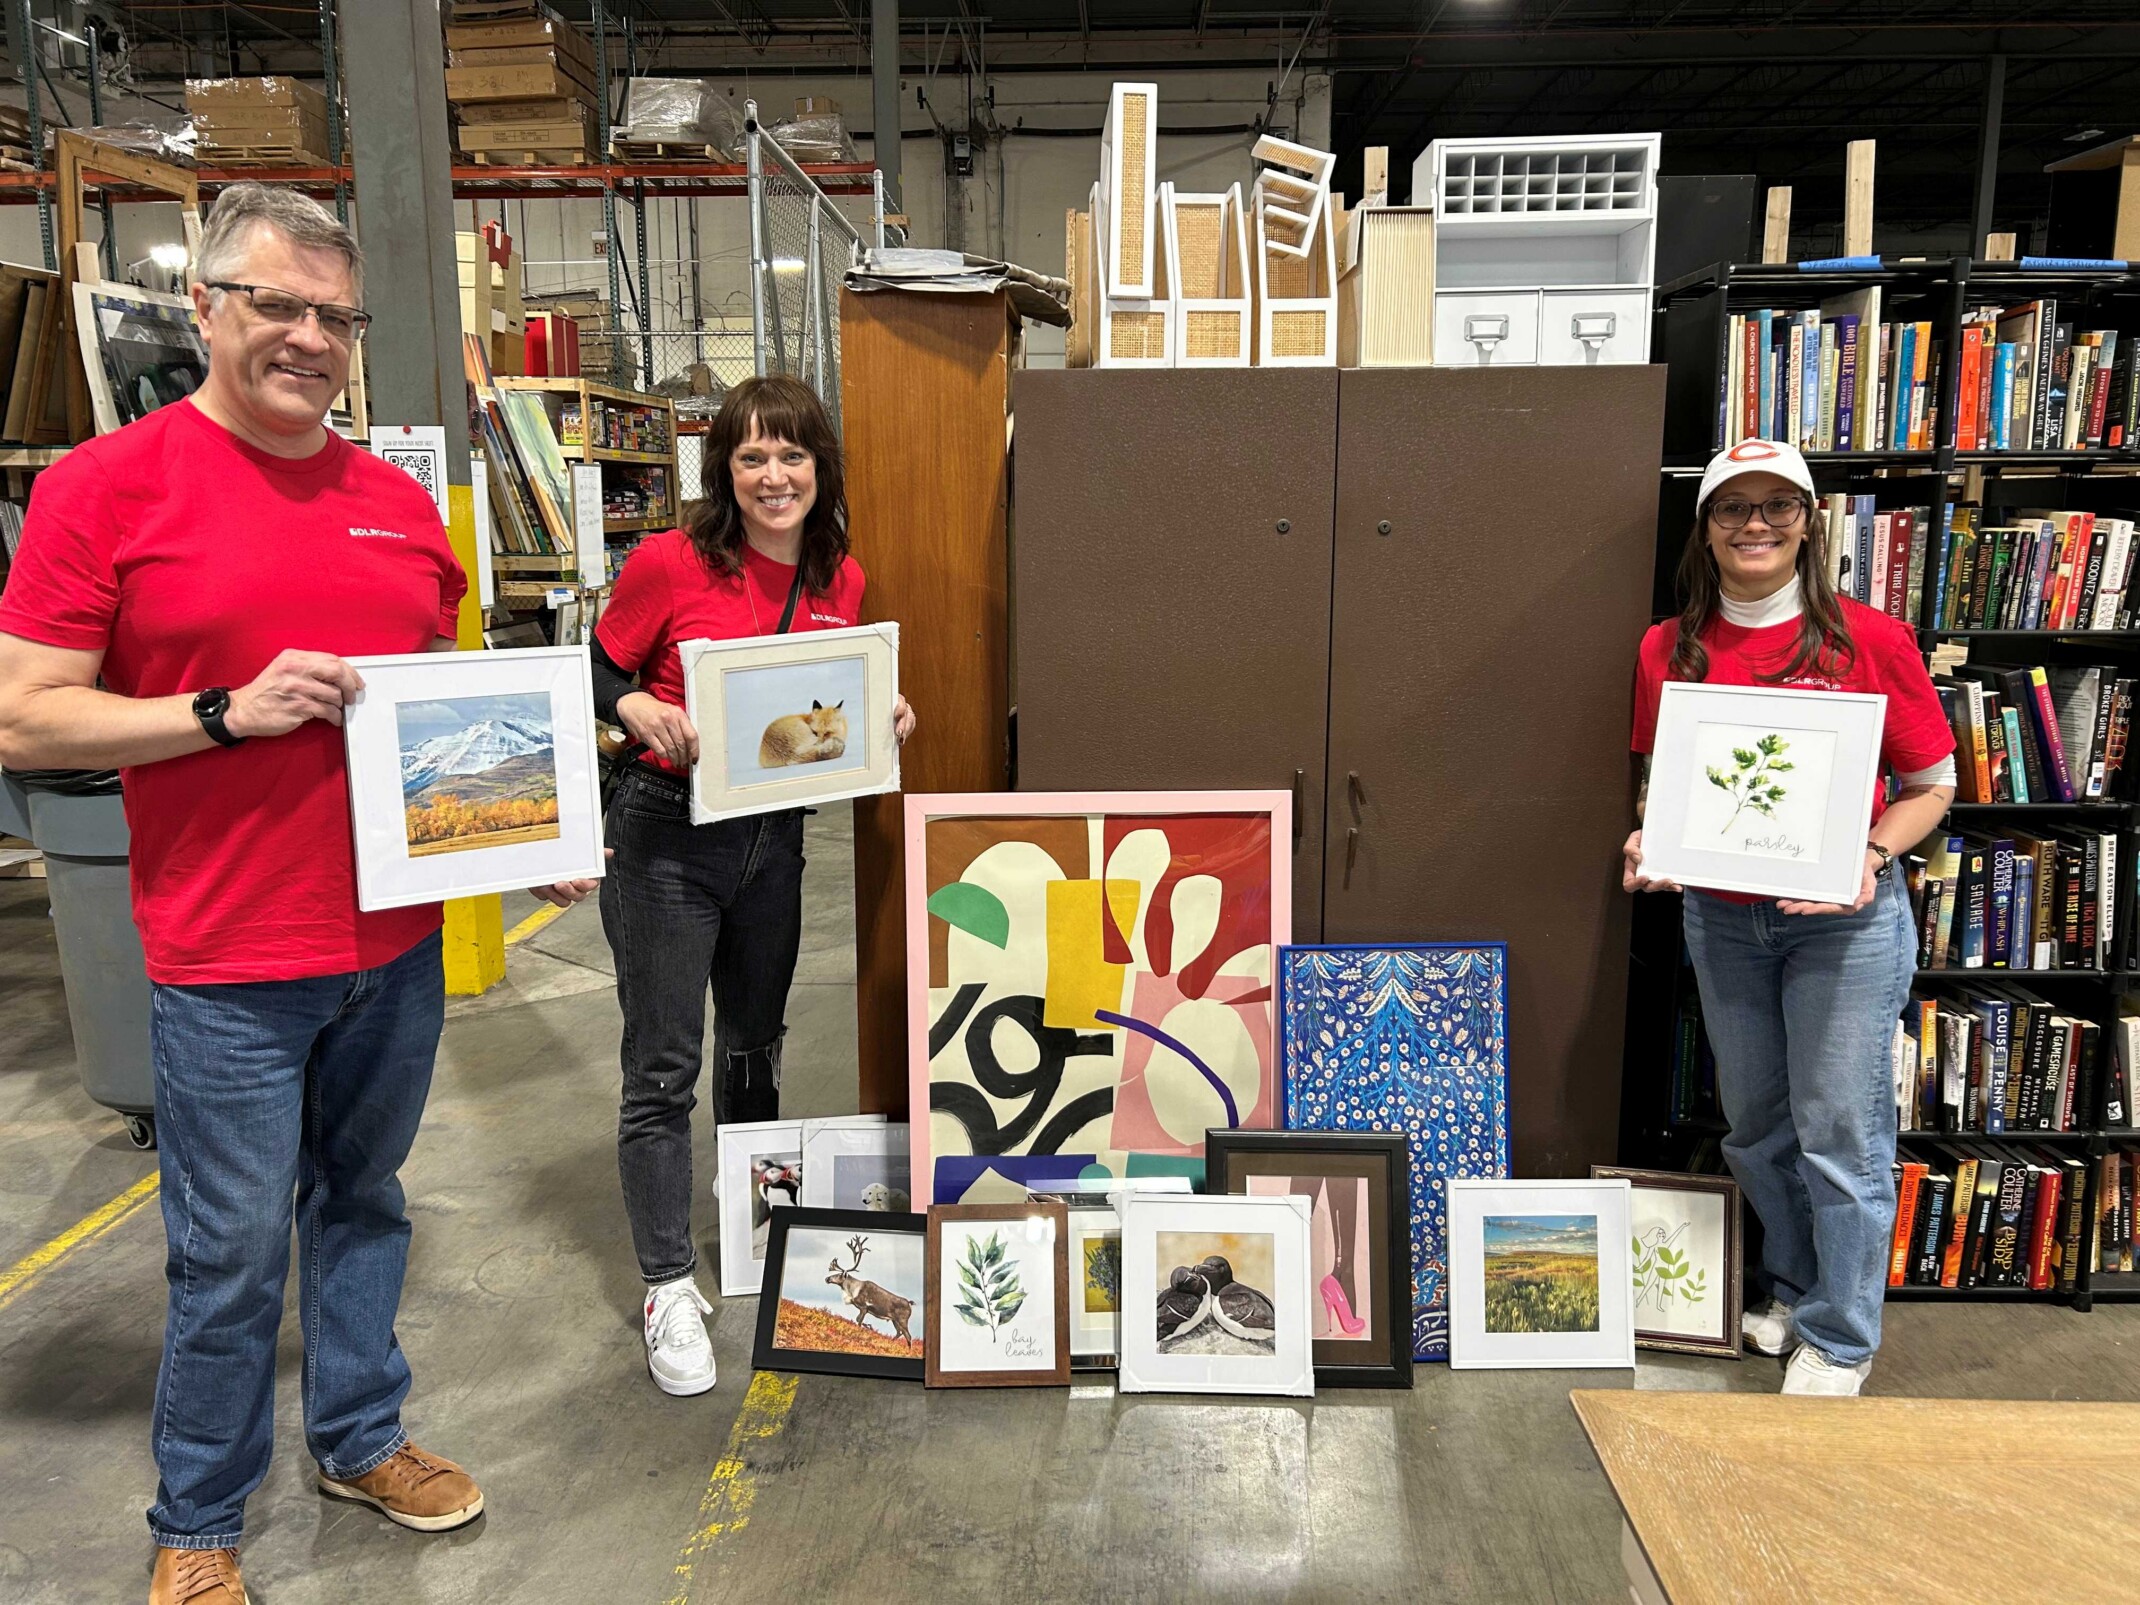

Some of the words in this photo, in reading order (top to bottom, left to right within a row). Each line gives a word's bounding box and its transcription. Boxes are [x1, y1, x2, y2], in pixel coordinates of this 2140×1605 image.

[595, 242, 607, 254] EXI
[1845, 324, 1855, 343] 1001
[2043, 307, 2052, 338] MARTHA
[1749, 355, 1755, 365] ON
[1842, 344, 1856, 375] BIBLE
[2041, 340, 2049, 369] GRIMES
[2038, 373, 2047, 411] FADEAWAY
[2098, 371, 2106, 394] BEFORE
[1790, 380, 1799, 414] TRAVELED
[1807, 395, 1815, 421] JENNINGS
[2075, 388, 2084, 412] HIGGINS
[2097, 400, 2103, 408] GO
[2036, 414, 2044, 431] GIRL
[2050, 419, 2058, 437] LISA
[2067, 525, 2077, 561] PERFUME
[2078, 546, 2086, 564] HOPE
[2114, 536, 2125, 561] JEFFERY
[1979, 545, 1987, 569] LAYMON
[1892, 562, 1904, 589] BIBLE
[1978, 572, 1988, 585] COME
[2074, 566, 2082, 587] NEVER
[2084, 560, 2101, 595] KOONTZ
[2109, 562, 2120, 587] DEAVER
[1976, 586, 1986, 596] OUT
[2071, 589, 2079, 604] DIES
[1890, 592, 1902, 618] HOLY
[1973, 597, 1985, 619] TONIGHT
[1988, 600, 1998, 629] GERRITSEN
[2097, 598, 2107, 625] MOON
[2105, 603, 2114, 627] COLD
[1972, 687, 1982, 724] CHOPPING
[2100, 684, 2112, 715] BROKEN
[2043, 698, 2053, 721] STRANGER
[2049, 722, 2059, 743] UPSTAIRS
[2097, 717, 2107, 739] GIRLS
[2060, 767, 2068, 783] MATLIN
[1745, 834, 1804, 857] parsley
[2086, 839, 2097, 858] JAMES
[1993, 851, 2005, 892] COULTER
[2005, 850, 2013, 892] CATHERINE
[2043, 846, 2053, 875] RUTH
[2068, 879, 2080, 893] THE
[2085, 860, 2096, 892] PATTERSON
[1943, 886, 1956, 914] FURY
[1969, 884, 1984, 929] SALVAGE
[2041, 878, 2051, 908] WARE
[2067, 895, 2078, 912] RISE
[2066, 914, 2078, 924] OF
[2084, 901, 2095, 922] TICK
[1996, 907, 2007, 951] WHIPLASH
[2040, 921, 2048, 930] IT
[2065, 925, 2077, 943] NINE
[2082, 925, 2094, 948] TOCK
[1997, 1008, 2007, 1053] LOUISE
[2015, 1007, 2026, 1037] CRICHTON
[2032, 1014, 2046, 1068] DISCLOSURE
[2010, 1040, 2024, 1073] PATTERSON
[2045, 1036, 2063, 1091] GAMESHOUSE
[1993, 1071, 2003, 1112] PENNY
[2005, 1082, 2019, 1119] ERUPTION
[2019, 1075, 2031, 1119] CRICHTON
[2030, 1078, 2041, 1117] MICHAEL
[2065, 1091, 2073, 1118] SHADOWS
[1968, 1097, 1978, 1121] JOHANSEN
[1964, 1165, 1974, 1182] JAMES
[2073, 1170, 2084, 1199] CRICHTON
[1904, 1181, 1914, 1201] DAVID
[1959, 1184, 1972, 1214] PATTERSON
[1999, 1168, 2016, 1211] COULTER
[2013, 1169, 2027, 1211] CATHERINE
[1932, 1194, 1943, 1215] JAMES
[1899, 1204, 1910, 1236] BALDACCI
[1953, 1214, 1968, 1245] BURN
[2069, 1202, 2082, 1235] PATTERSON
[1925, 1217, 1940, 1254] PATTERSON
[1893, 1248, 1906, 1273] FALLEN
[1993, 1237, 2005, 1265] SIDE
[2003, 1233, 2016, 1270] BLIND
[2064, 1243, 2079, 1281] ERUPTION
[1920, 1259, 1928, 1272] BACK
[1006, 1341, 1043, 1357] leaves
[1012, 1328, 1037, 1349] bay
